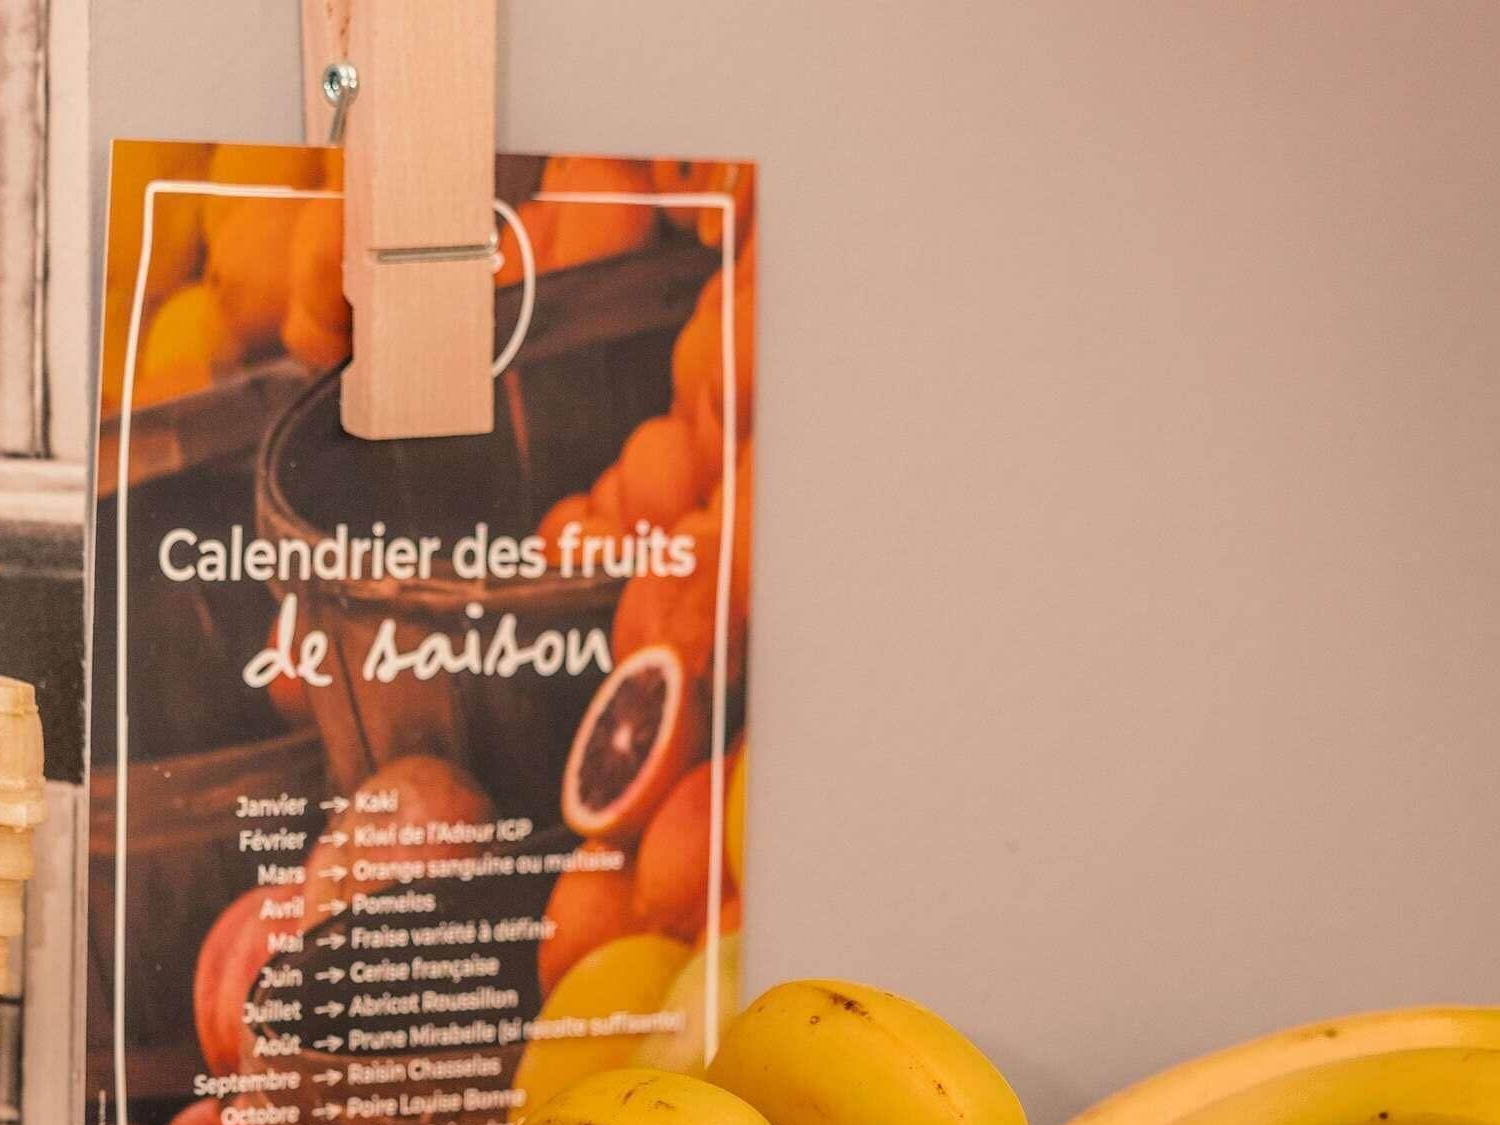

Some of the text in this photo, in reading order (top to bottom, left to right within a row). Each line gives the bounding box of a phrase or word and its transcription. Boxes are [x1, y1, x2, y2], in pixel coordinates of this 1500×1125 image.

[158, 520, 697, 582] Calendrier des fruits
[242, 593, 615, 689] de saison
[236, 789, 398, 817] Janvier Kaki
[239, 827, 307, 852] Février
[354, 822, 397, 847] Kiwi
[398, 822, 425, 845] de
[258, 864, 306, 885] Mars
[352, 859, 425, 884] Orange
[426, 851, 515, 881] sanguine
[516, 855, 543, 874] ou
[259, 889, 437, 920] Avril Pomelos
[267, 929, 304, 954] Mai
[352, 923, 409, 949] Fraise
[410, 919, 477, 946] variété
[477, 918, 493, 943] à
[259, 952, 500, 988] Juin Cerise française
[242, 985, 519, 1024] Juillet Abricot Roussillon
[253, 1033, 301, 1057] Août
[348, 1029, 408, 1051] Prune
[409, 1019, 497, 1047] Mirabelle
[193, 1053, 502, 1099] Septembre Raisin Chasselas
[346, 1093, 398, 1119] Poire
[399, 1088, 463, 1116] Louise
